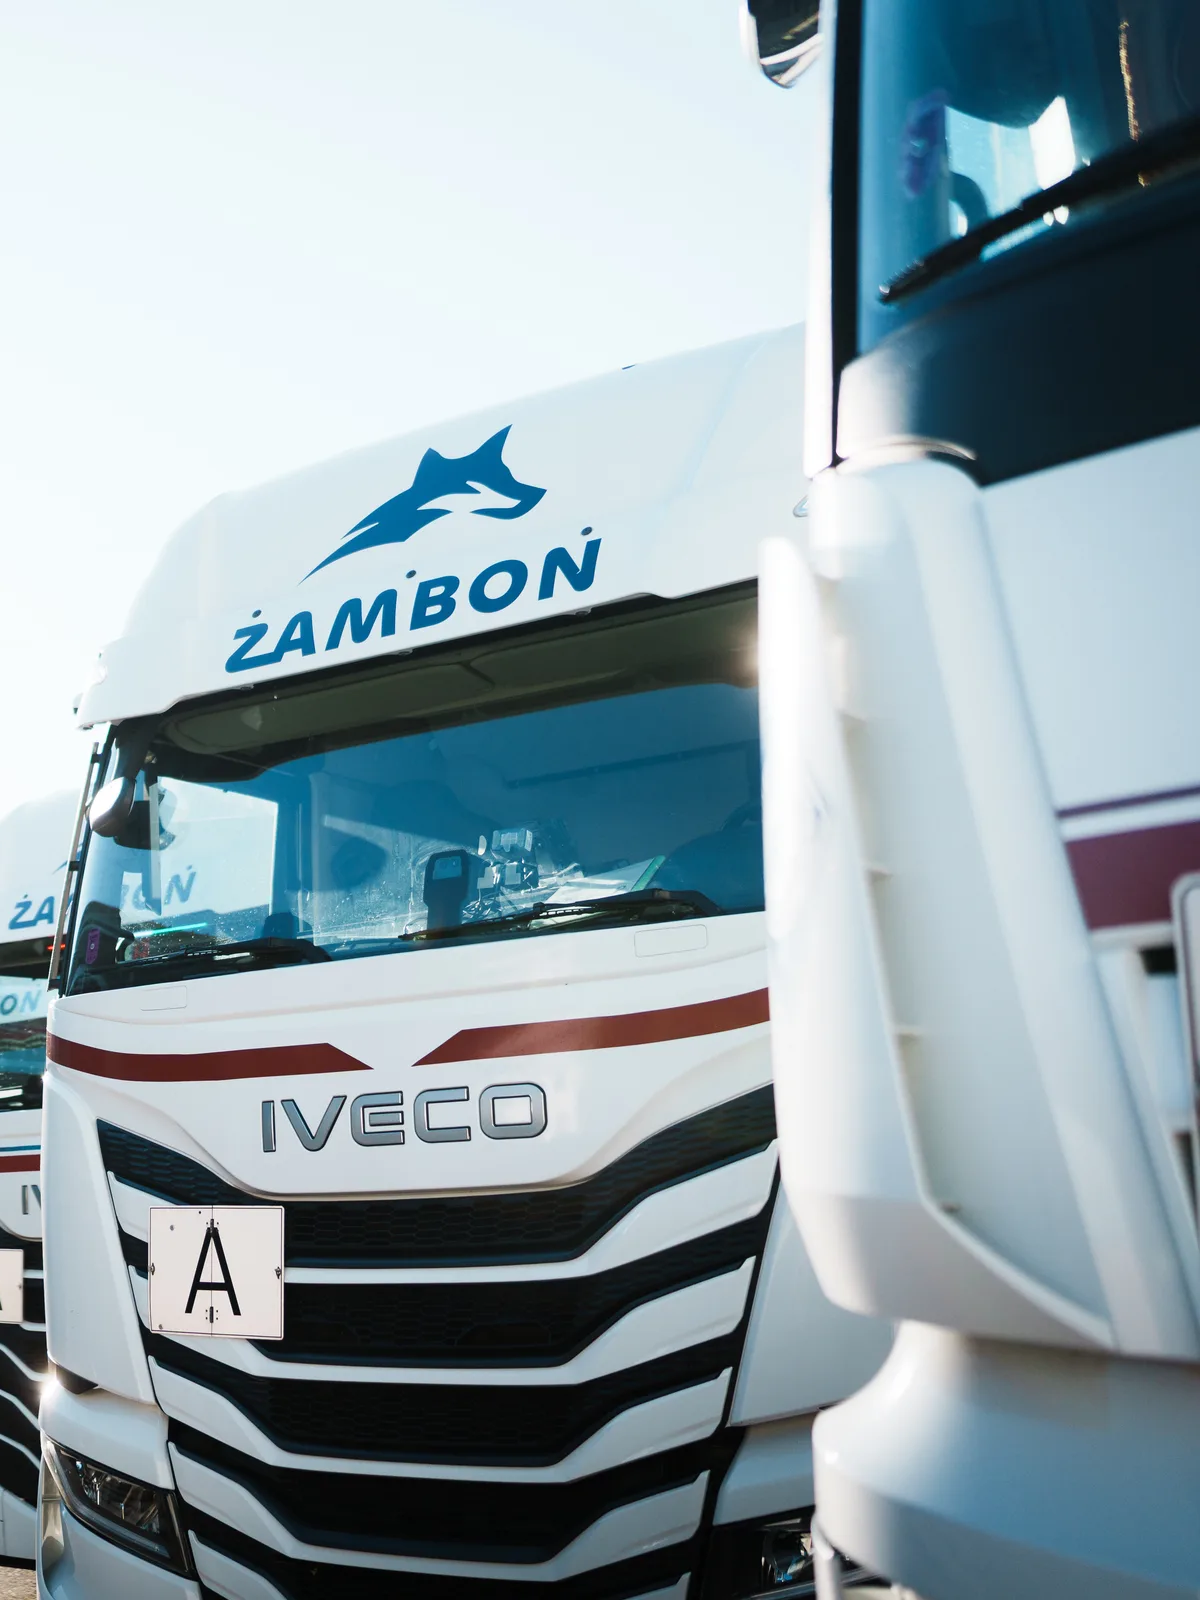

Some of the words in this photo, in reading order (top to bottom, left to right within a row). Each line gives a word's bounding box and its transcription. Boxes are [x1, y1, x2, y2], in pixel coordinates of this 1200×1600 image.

[225, 537, 602, 674] ZAMBON
[261, 1081, 548, 1153] IVECO
[185, 1226, 242, 1316] A
